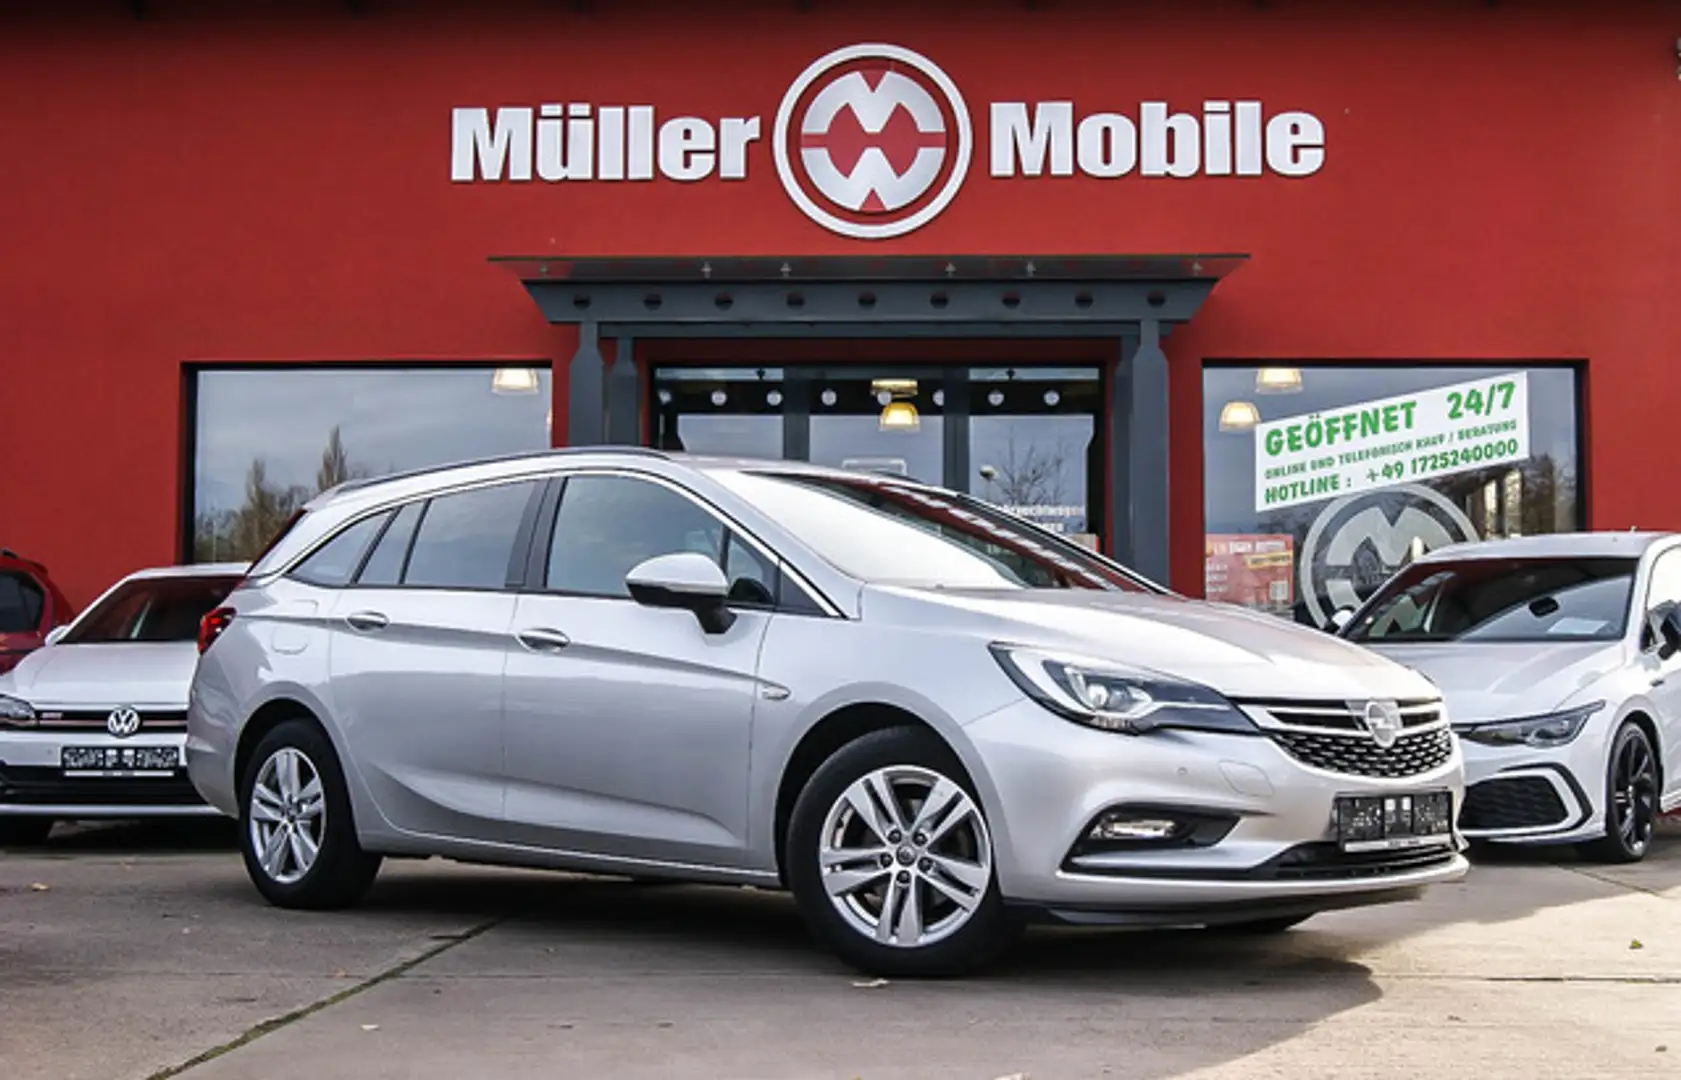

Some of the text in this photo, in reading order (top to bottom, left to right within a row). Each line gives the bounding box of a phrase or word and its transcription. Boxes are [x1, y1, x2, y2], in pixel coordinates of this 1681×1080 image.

[451, 103, 760, 182] Müller
[989, 100, 1325, 178] Mobile
[1265, 381, 1516, 457] GEÖFFNET 24/7
[1264, 461, 1307, 480] ONLINE
[1310, 456, 1335, 471] UND
[1264, 473, 1340, 504] HOTLINE
[1366, 460, 1405, 483] +49
[1411, 438, 1518, 475] 1725240000
